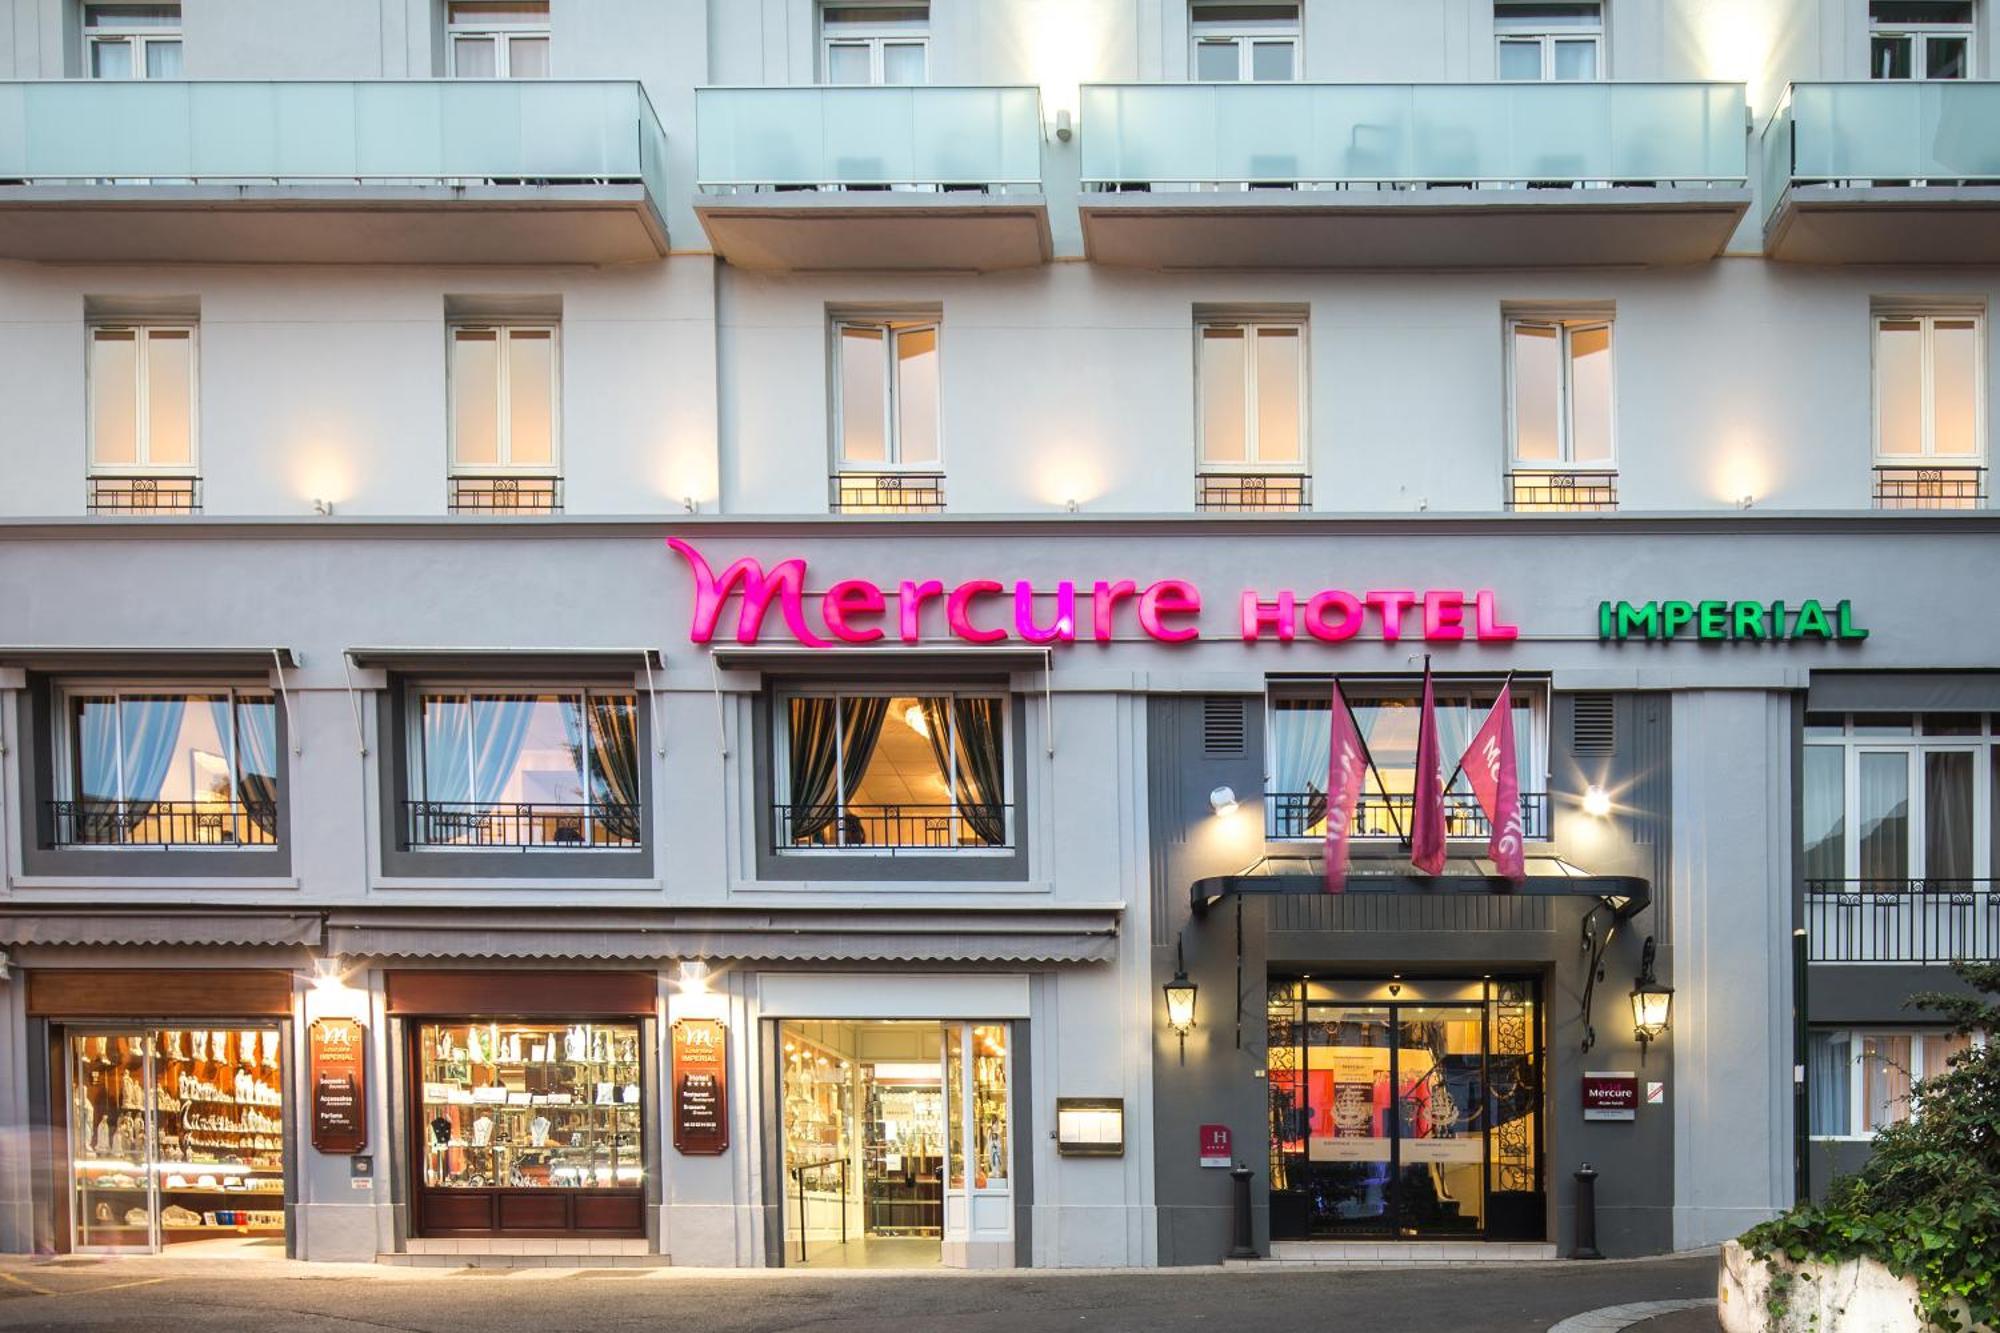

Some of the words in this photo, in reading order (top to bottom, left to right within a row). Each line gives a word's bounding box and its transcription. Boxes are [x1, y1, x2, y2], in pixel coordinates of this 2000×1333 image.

[667, 537, 1201, 648] Mercure
[1241, 590, 1519, 642] HOTEL
[1598, 599, 1870, 642] IMPERIAL
[1589, 1089, 1633, 1098] Mercure
[1213, 1131, 1227, 1143] H
